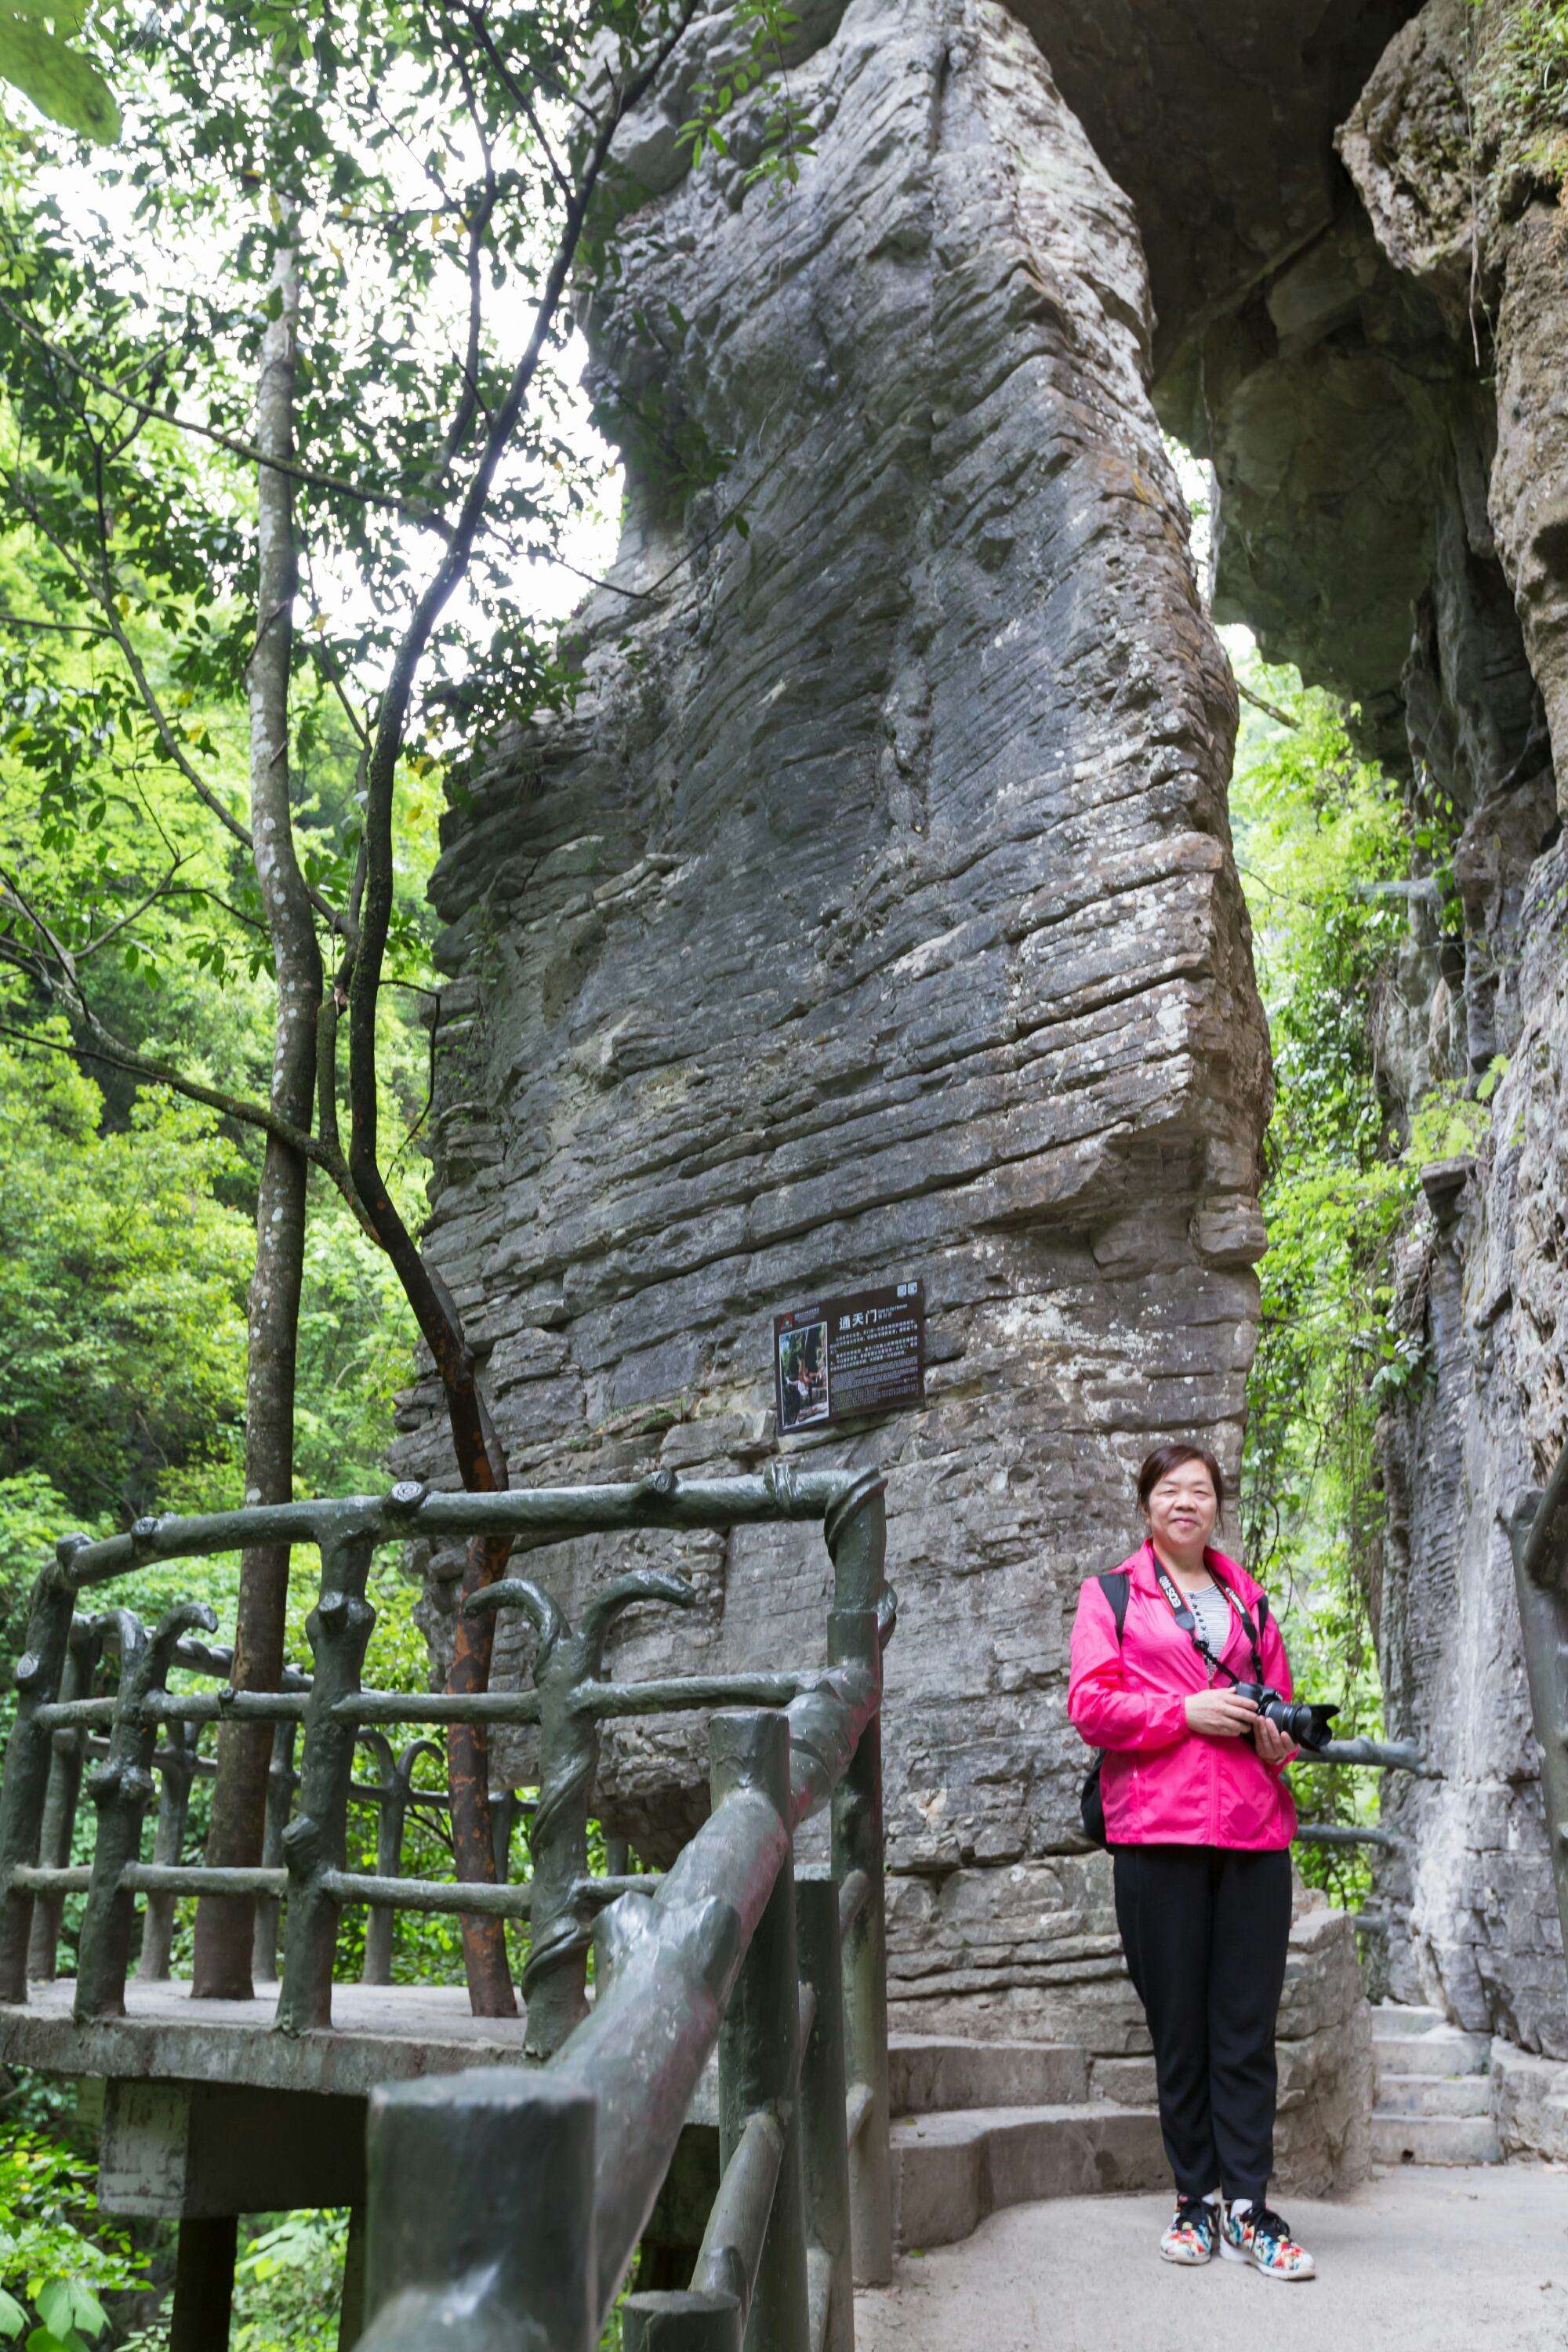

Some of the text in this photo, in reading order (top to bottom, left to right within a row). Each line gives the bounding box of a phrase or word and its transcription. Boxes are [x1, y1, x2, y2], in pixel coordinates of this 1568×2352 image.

[839, 1308, 877, 1331] 通天门
[1165, 1587, 1181, 1608] EOS
